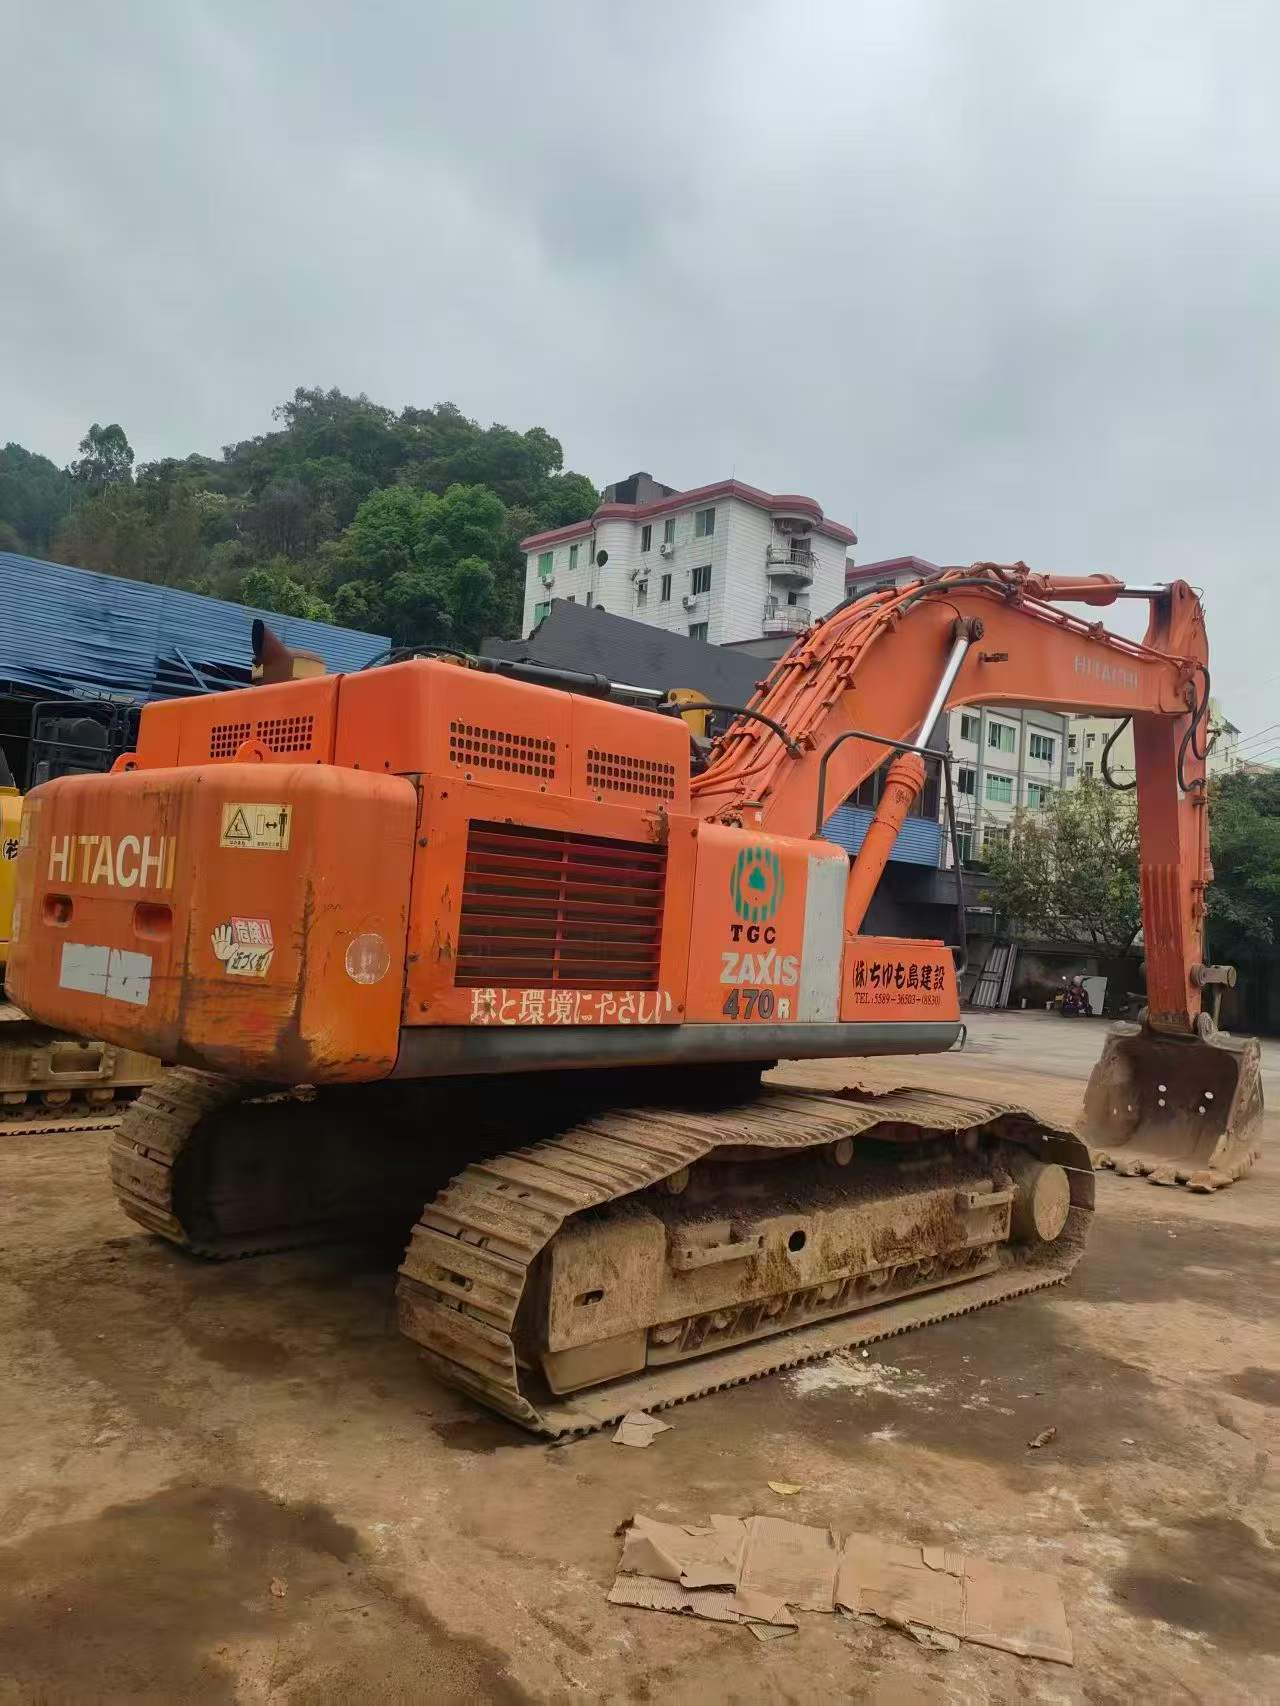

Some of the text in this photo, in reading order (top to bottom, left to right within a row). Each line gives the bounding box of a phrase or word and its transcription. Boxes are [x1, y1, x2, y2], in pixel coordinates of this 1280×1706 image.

[48, 834, 177, 889] HITACHI
[731, 924, 776, 944] TGC
[720, 948, 800, 986] ZAXIS
